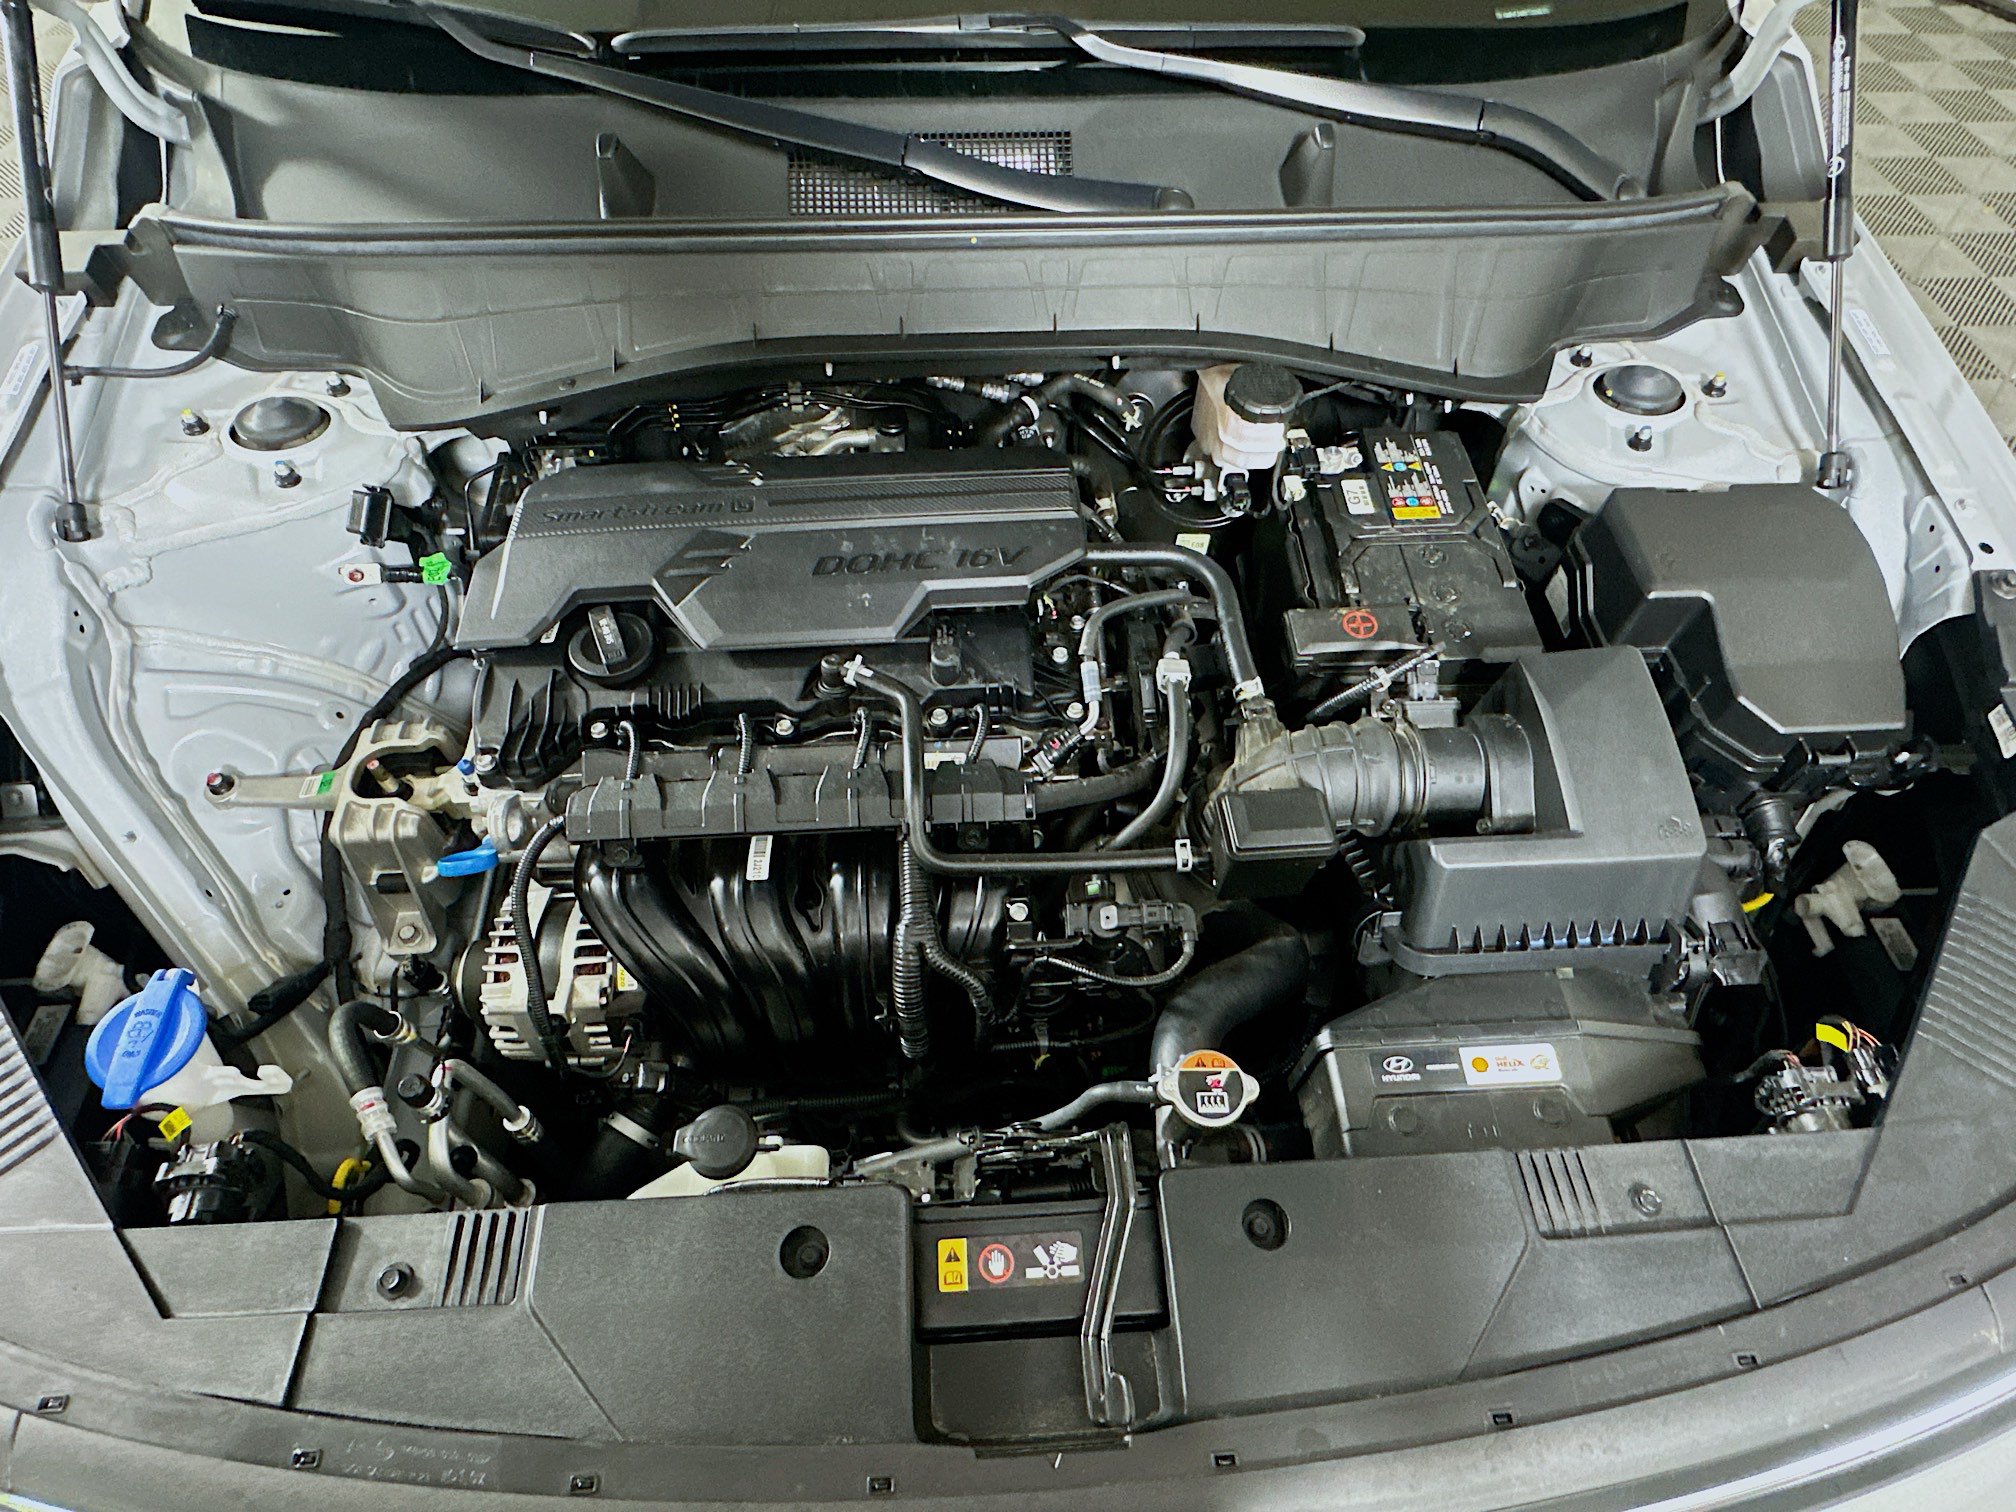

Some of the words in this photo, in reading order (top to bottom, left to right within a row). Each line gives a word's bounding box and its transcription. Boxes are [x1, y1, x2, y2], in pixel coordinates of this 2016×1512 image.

[1347, 490, 1360, 505] G7
[542, 501, 725, 523] Smartstream
[812, 549, 943, 576] DOHC
[955, 545, 1030, 570] 16V
[1496, 1059, 1525, 1067] HELIX
[1381, 1073, 1422, 1083] HYUNDAI
